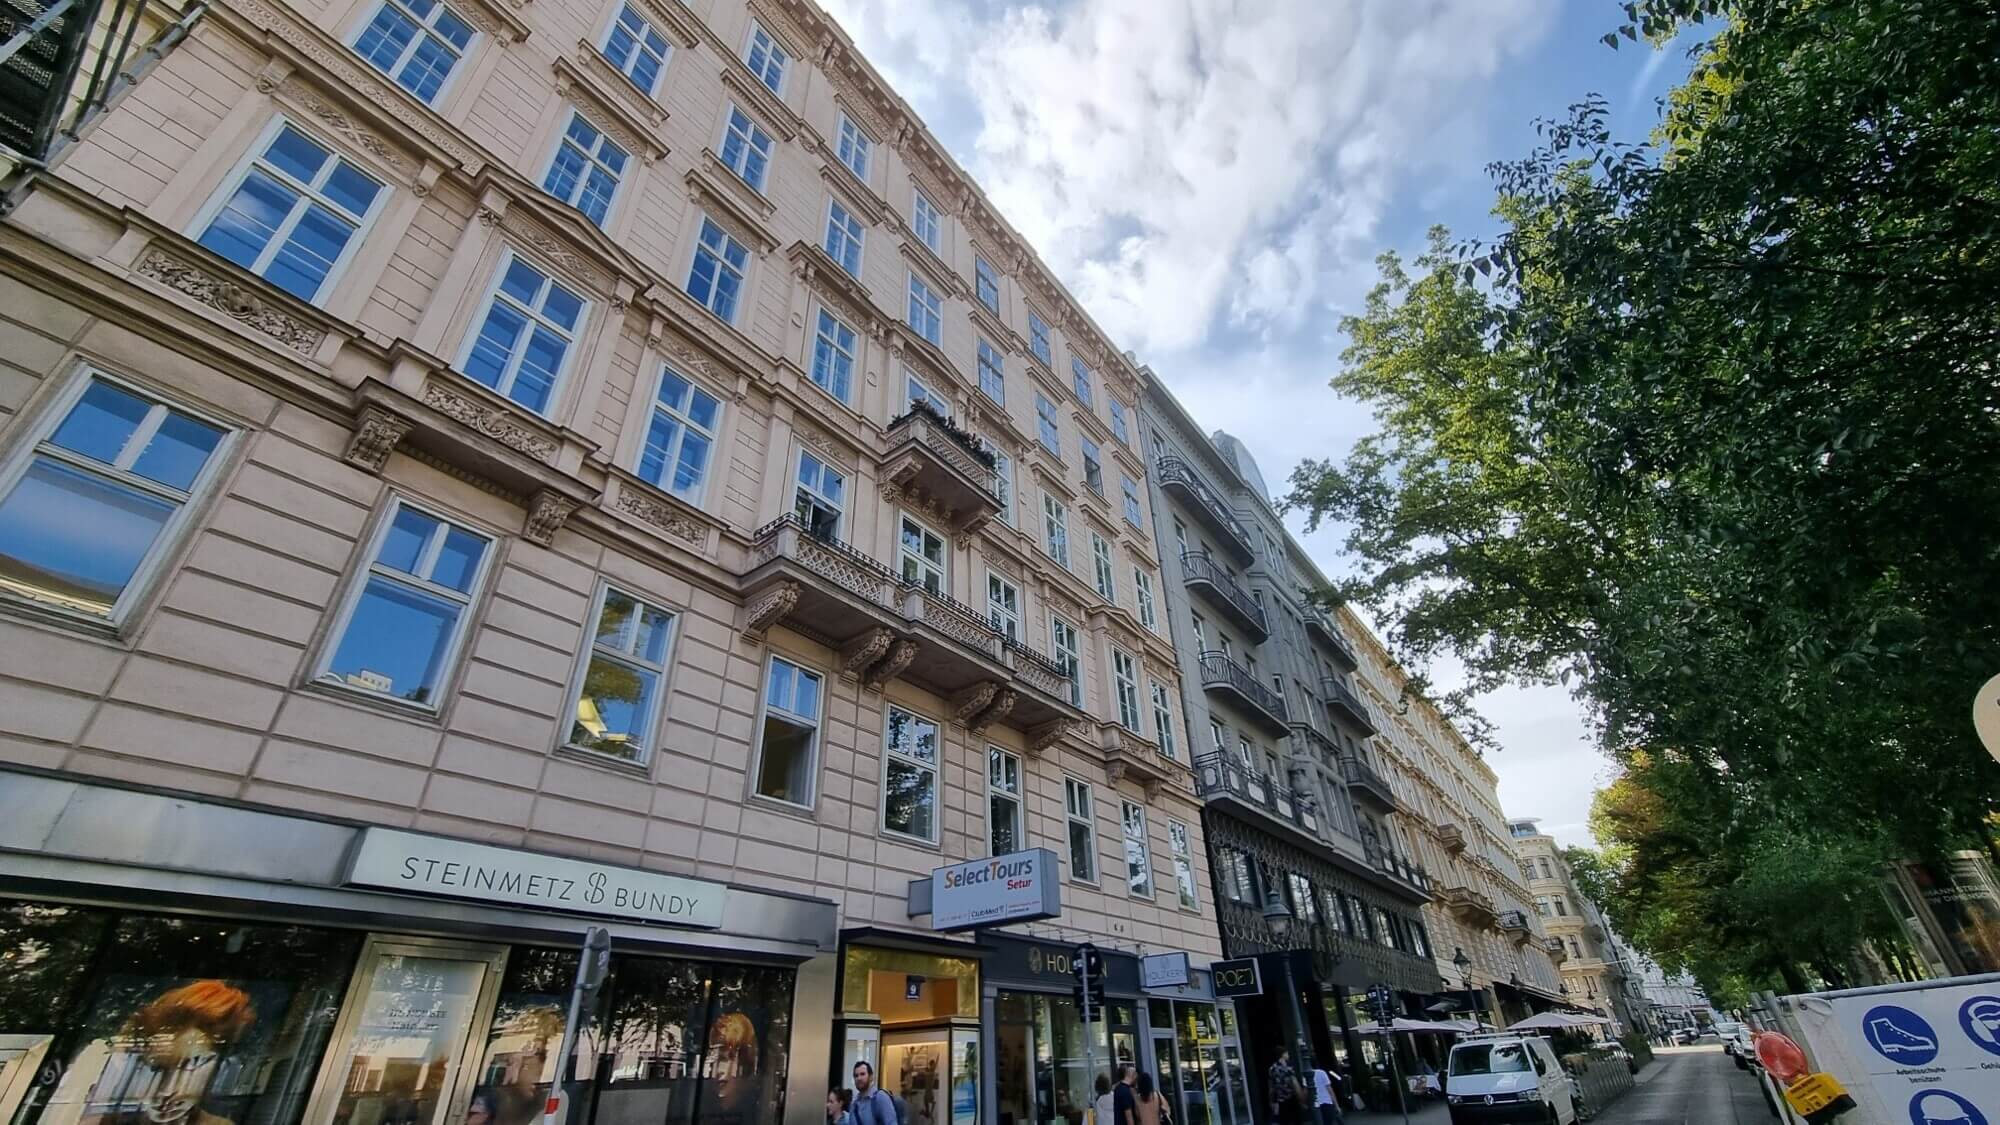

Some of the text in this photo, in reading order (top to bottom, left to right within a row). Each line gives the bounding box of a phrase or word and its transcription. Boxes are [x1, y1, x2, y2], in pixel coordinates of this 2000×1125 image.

[945, 859, 1033, 889] SelectTours
[1007, 878, 1032, 890] Setur
[401, 856, 576, 902] STEINMETZ
[614, 886, 699, 918] BUNDY
[909, 984, 917, 994] 9
